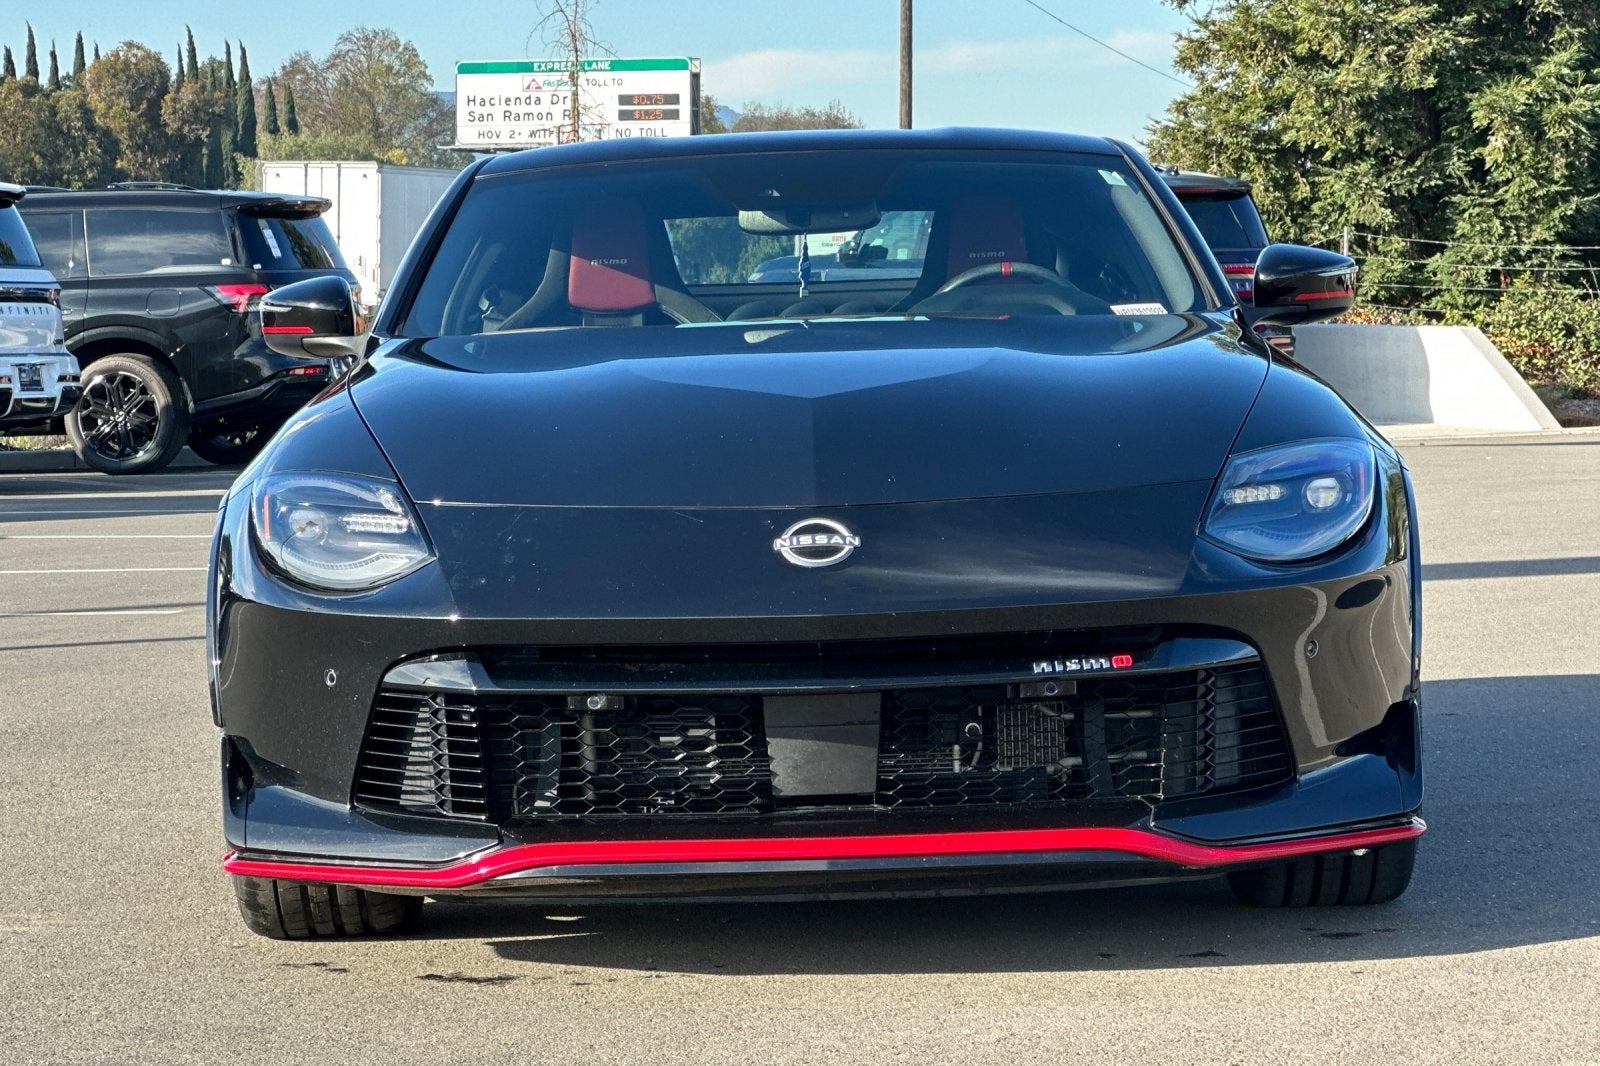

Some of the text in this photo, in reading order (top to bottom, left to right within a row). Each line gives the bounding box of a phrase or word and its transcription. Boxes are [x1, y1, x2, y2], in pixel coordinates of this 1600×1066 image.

[533, 61, 611, 72] EXPRES LANE
[585, 78, 609, 87] TOLL
[612, 78, 623, 87] TO
[466, 93, 569, 107] Hacienda Dr
[632, 94, 665, 105] $0.75
[468, 110, 494, 123] San
[503, 109, 553, 122] Ramon
[633, 109, 664, 120] $1.25
[477, 130, 501, 140] HOV
[509, 130, 522, 140] 2+
[615, 127, 632, 138] NO
[639, 127, 668, 138] TOLL
[590, 257, 628, 266] nismo
[776, 534, 859, 548] NISSAN
[1032, 654, 1133, 674] nismo
